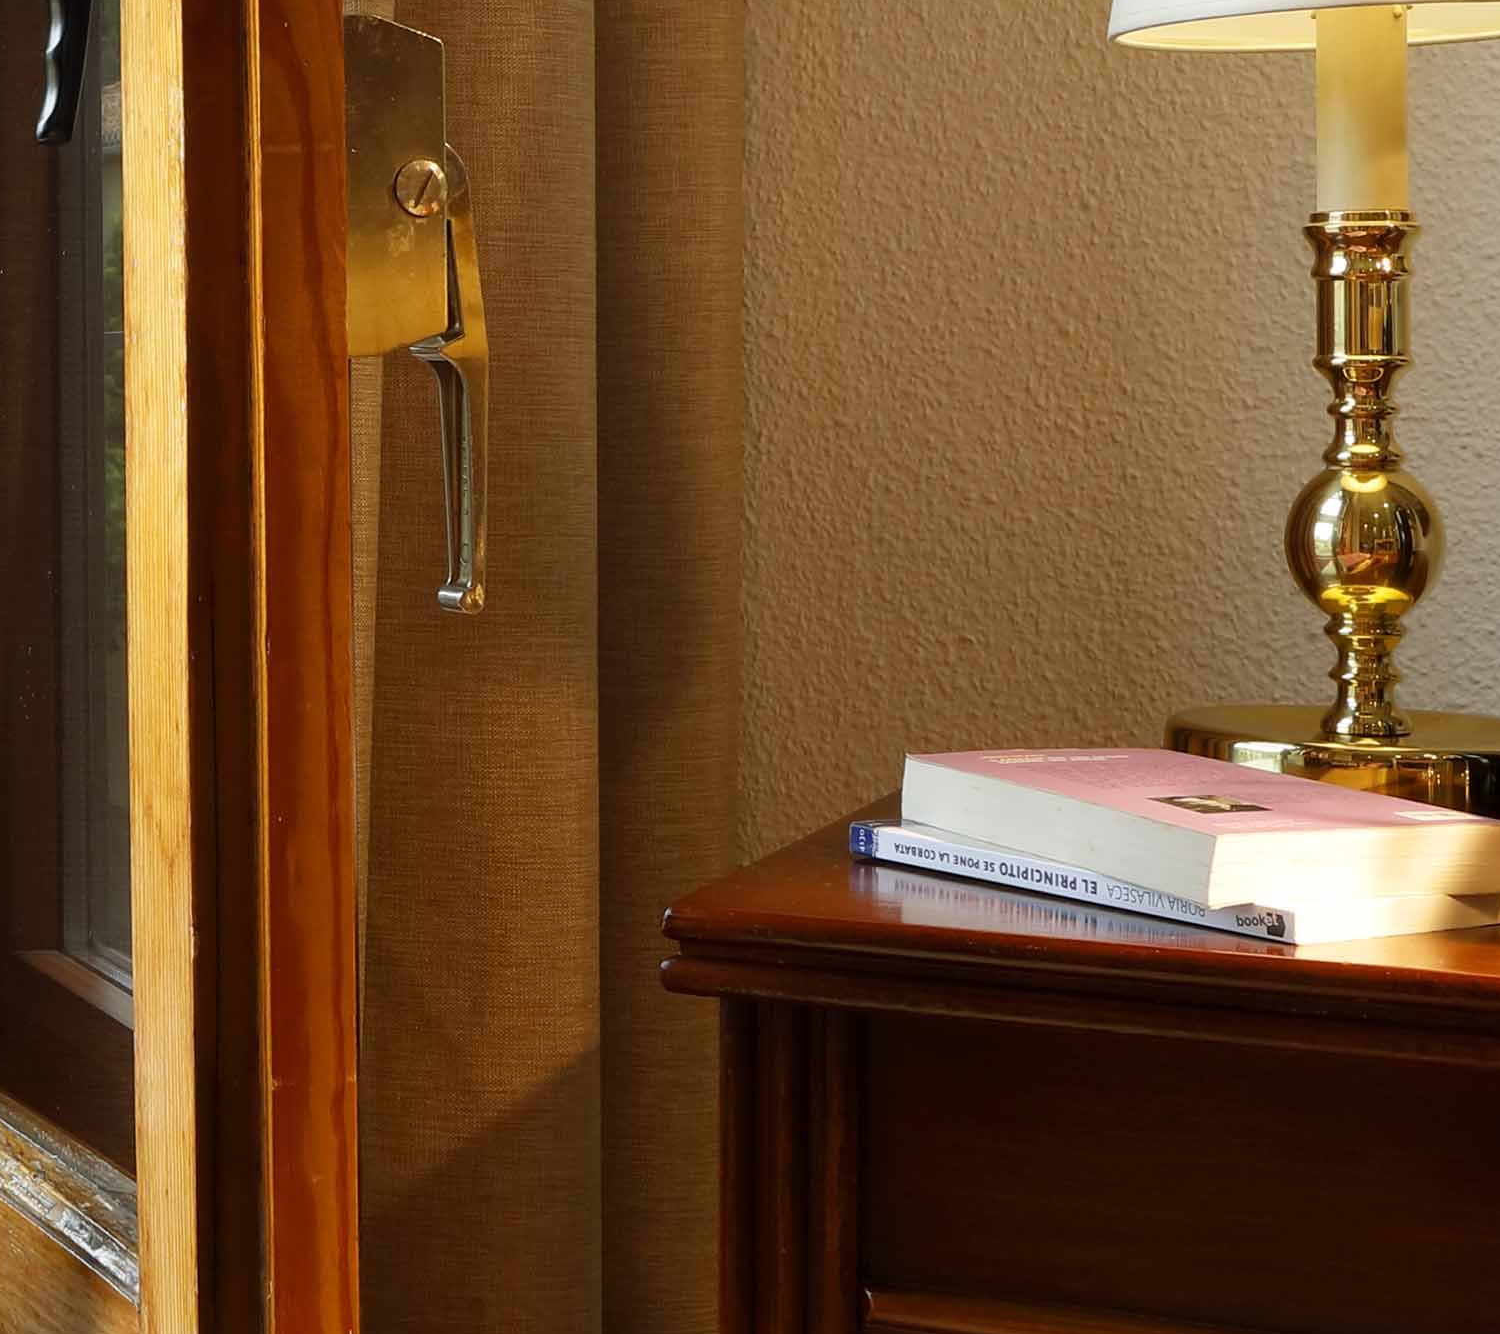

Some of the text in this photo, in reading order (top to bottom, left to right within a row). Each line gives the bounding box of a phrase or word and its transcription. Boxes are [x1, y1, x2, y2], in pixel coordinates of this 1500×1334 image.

[893, 842, 1098, 895] EL PRINCIPITO SE PONE LA CORBATA
[1107, 883, 1164, 908] VILASECA
